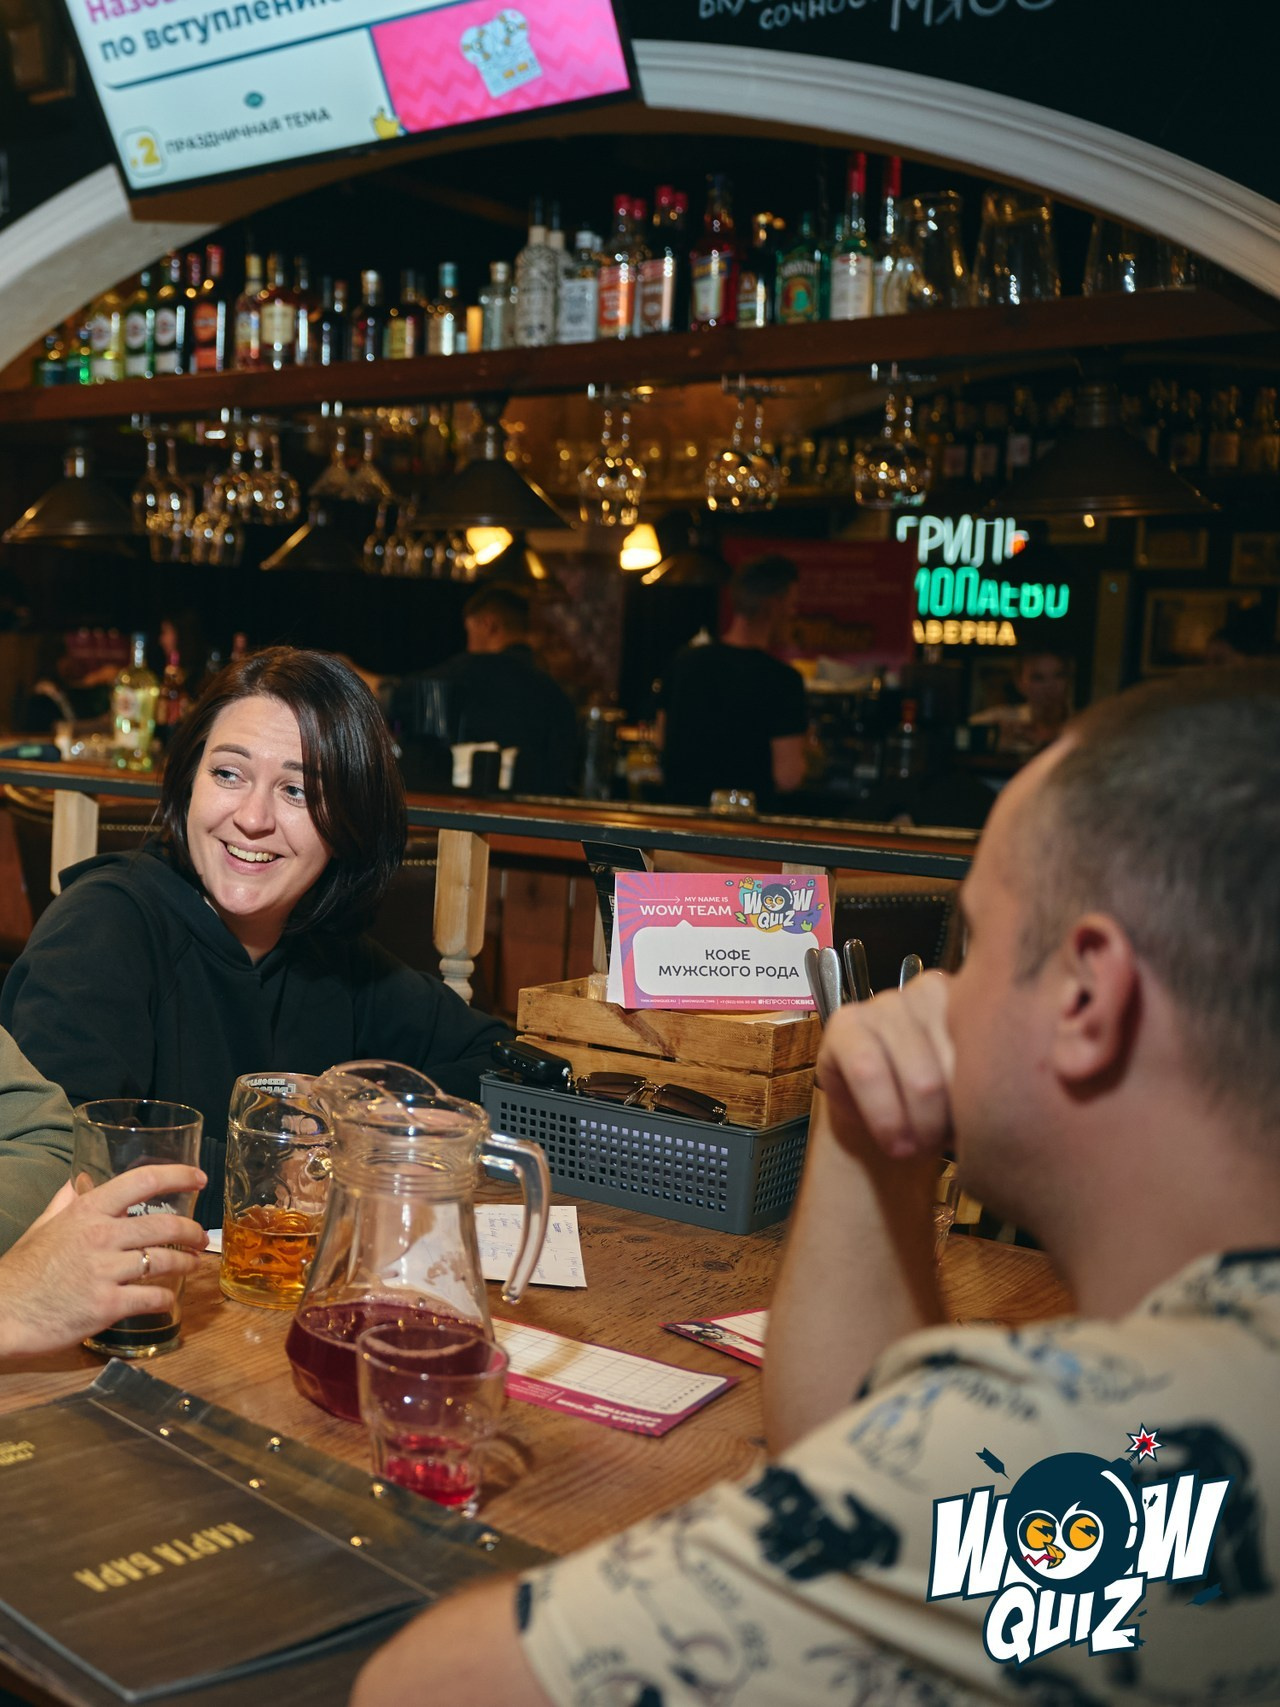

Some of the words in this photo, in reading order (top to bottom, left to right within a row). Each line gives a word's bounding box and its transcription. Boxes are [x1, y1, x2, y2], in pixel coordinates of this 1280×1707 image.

[99, 37, 137, 61] по
[144, 0, 344, 52] вступлени
[164, 118, 282, 155] ПРАЗДНИЧНАЯ
[283, 107, 332, 130] ТЕМА
[639, 905, 683, 916] WOW
[687, 905, 732, 916] TEAM
[757, 910, 796, 930] QUIZ
[705, 949, 751, 961] КОФЕ
[659, 965, 751, 977] МУЖСКОГО
[755, 966, 800, 979] РОДА
[152, 1521, 255, 1566] КАРТА
[72, 1552, 164, 1592] БАРА
